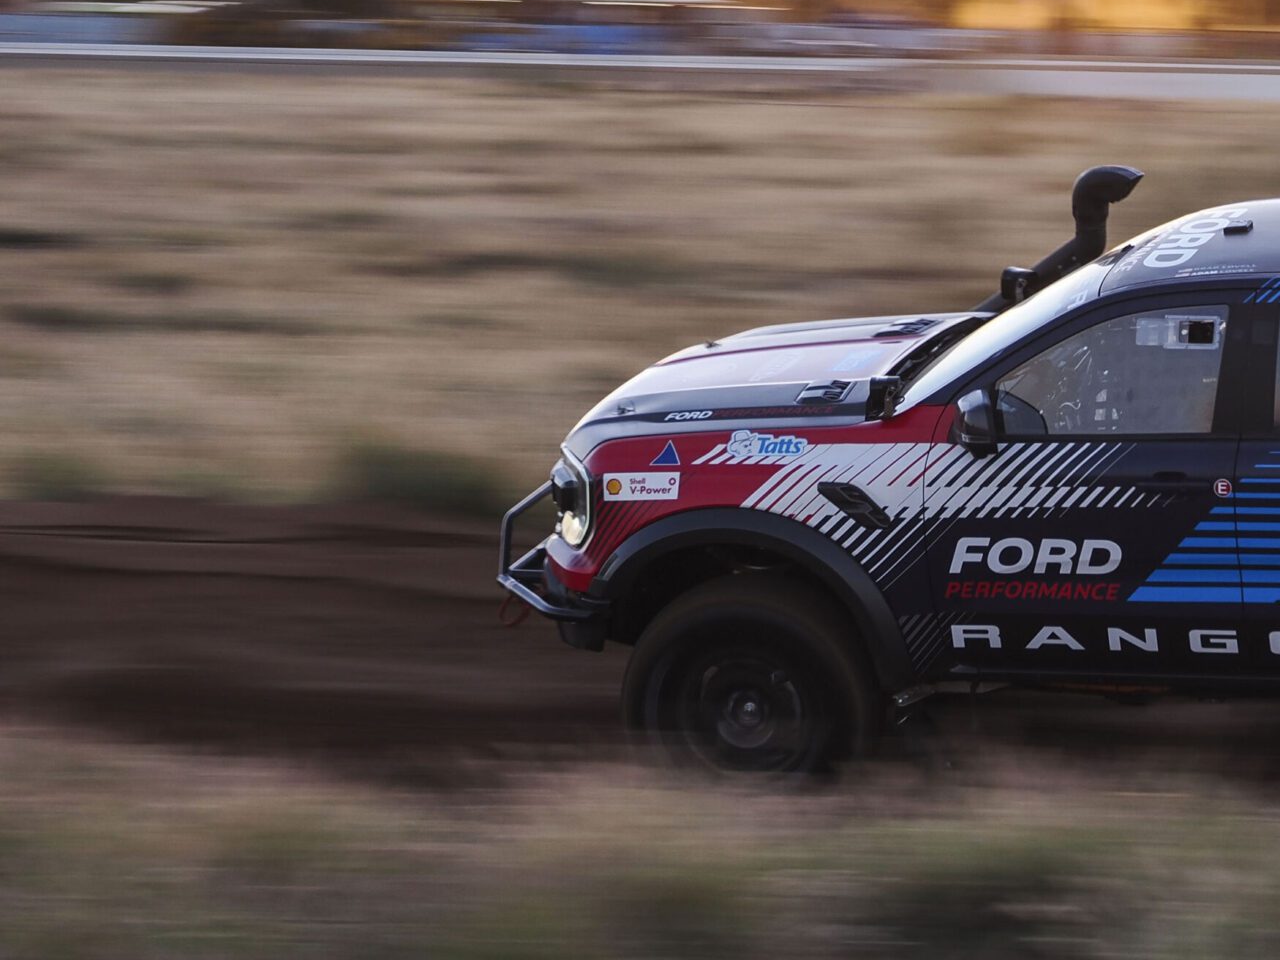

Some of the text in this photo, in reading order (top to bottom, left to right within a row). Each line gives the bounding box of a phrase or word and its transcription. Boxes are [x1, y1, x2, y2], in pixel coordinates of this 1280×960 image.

[664, 410, 714, 421] FORD
[757, 436, 803, 455] Tatts
[630, 486, 672, 496] V-Power
[1217, 482, 1229, 495] E
[948, 537, 1122, 575] FORD
[944, 580, 1121, 601] PERFORMANCE
